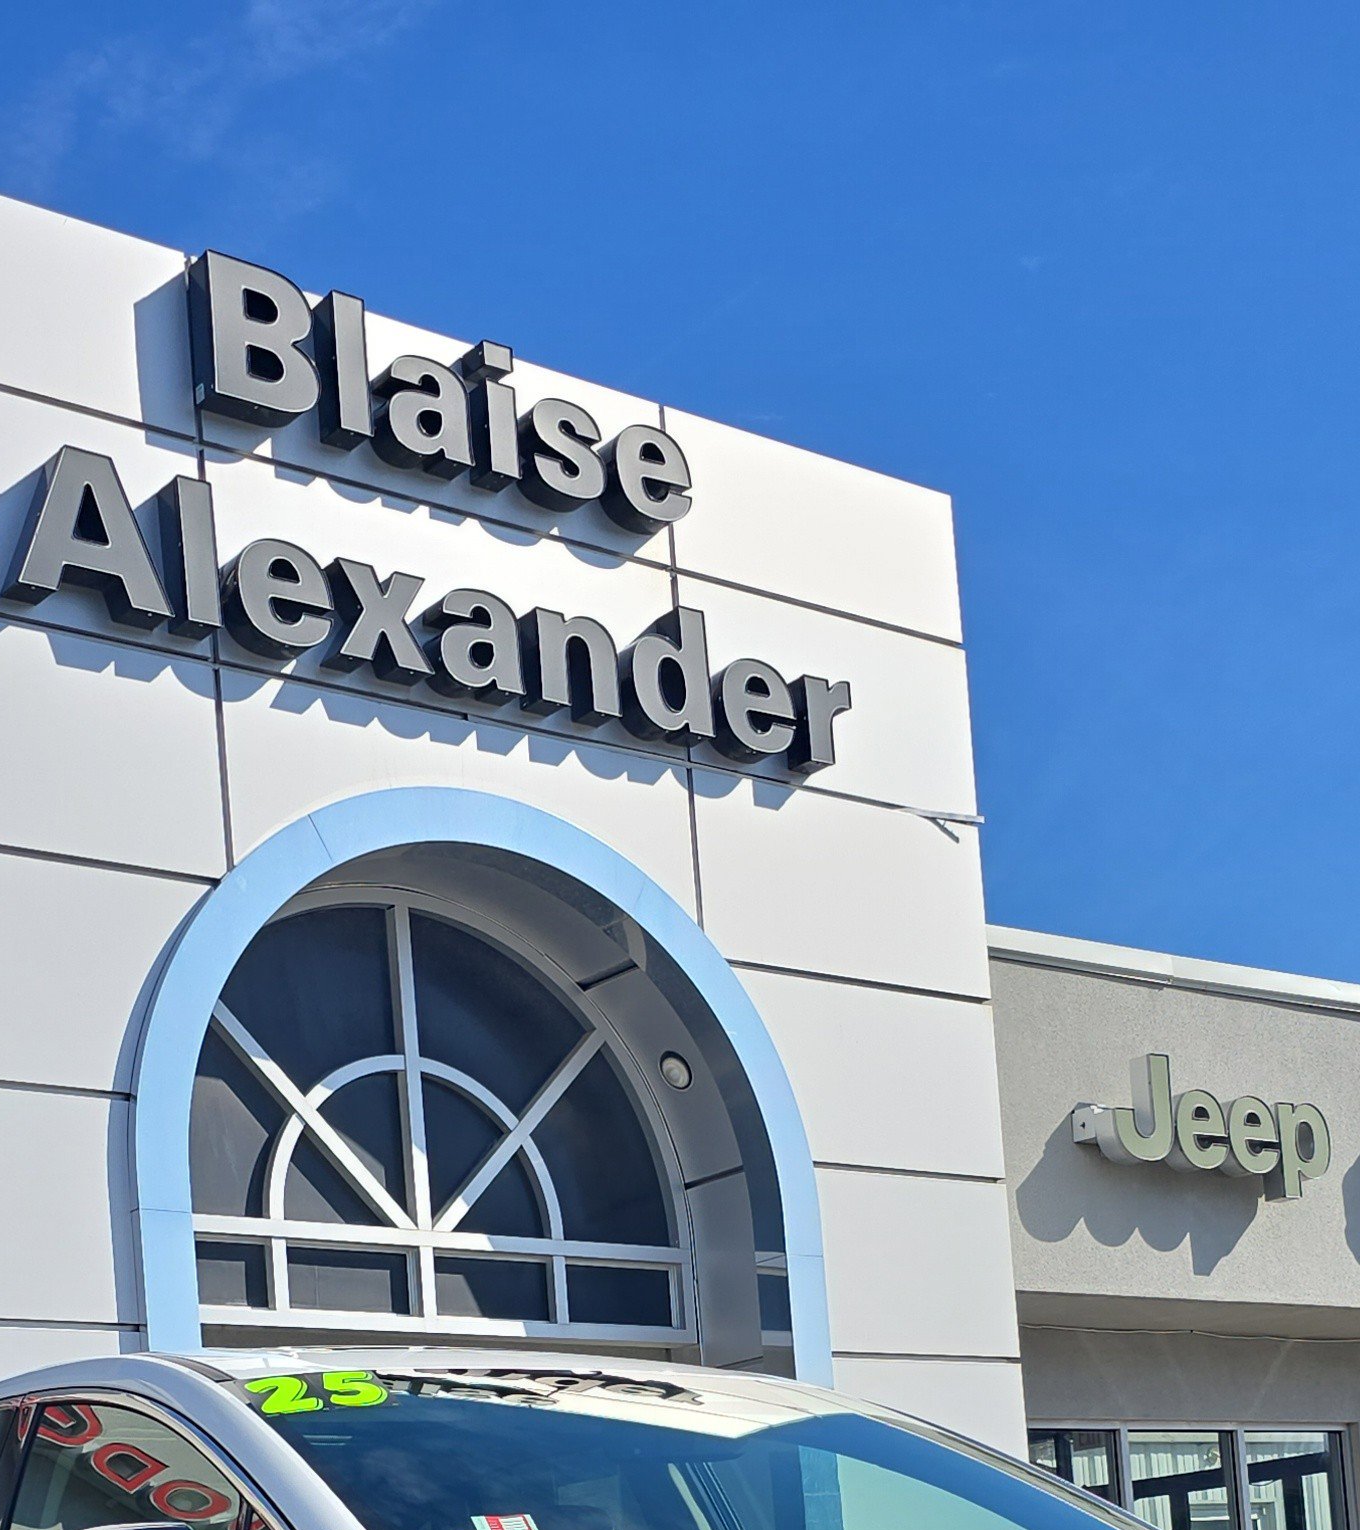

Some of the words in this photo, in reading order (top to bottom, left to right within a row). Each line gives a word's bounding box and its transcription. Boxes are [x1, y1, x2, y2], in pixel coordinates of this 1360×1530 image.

[194, 250, 693, 530] Blaise
[7, 445, 851, 771] Alexander
[1110, 1053, 1332, 1200] Jeep
[244, 1370, 389, 1415] 25
